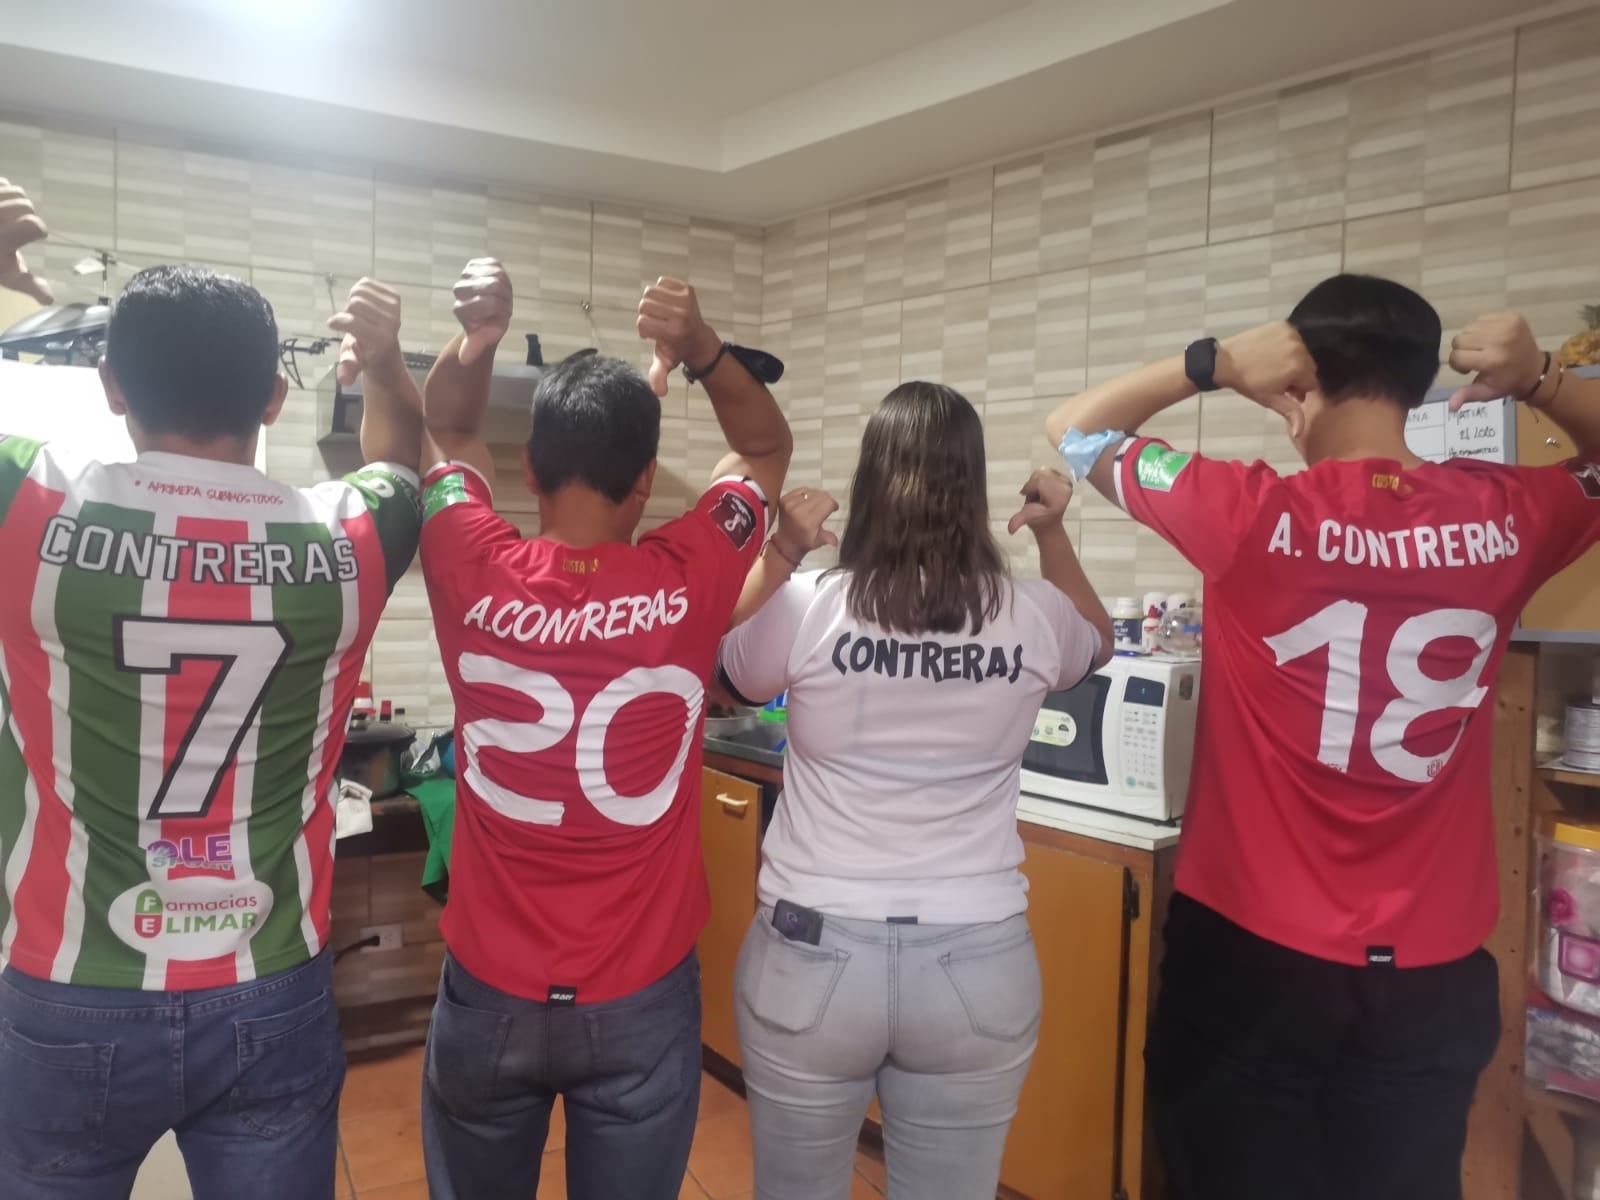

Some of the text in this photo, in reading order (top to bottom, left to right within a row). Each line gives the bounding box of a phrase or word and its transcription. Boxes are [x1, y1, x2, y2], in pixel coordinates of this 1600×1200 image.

[40, 515, 359, 586] CONTRERAS
[1267, 511, 1520, 569] A. CONTRERAS
[112, 612, 294, 820] 7
[832, 631, 1024, 684] CONTRERAS
[1262, 599, 1498, 783] 18
[458, 651, 705, 826] 20
